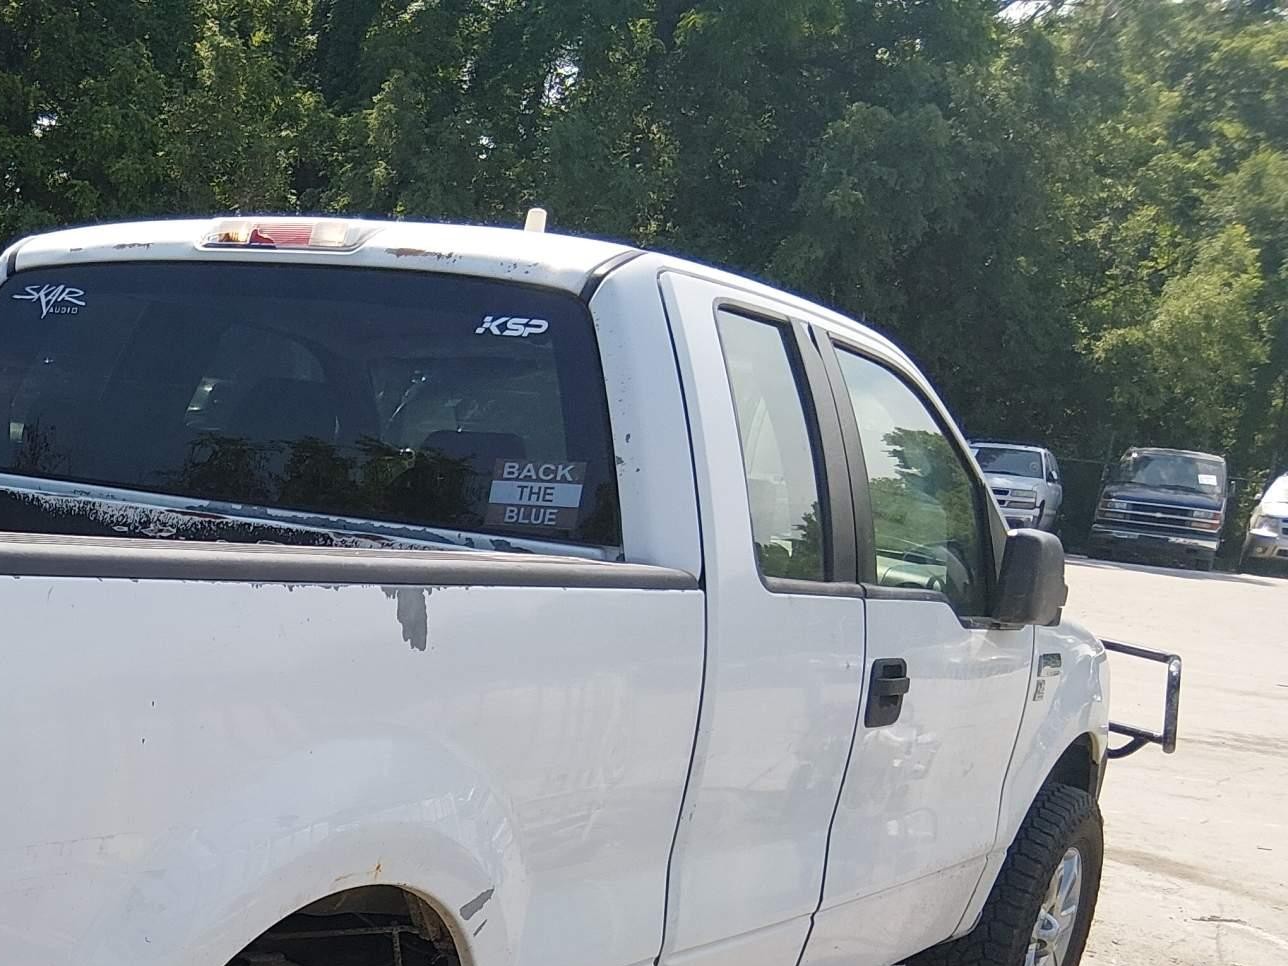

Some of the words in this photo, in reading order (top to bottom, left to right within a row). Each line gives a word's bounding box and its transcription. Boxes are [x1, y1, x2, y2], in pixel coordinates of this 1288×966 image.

[12, 284, 86, 319] SKAR
[49, 306, 79, 314] AUDIO
[475, 316, 549, 337] KSP
[503, 462, 575, 481] BACK
[517, 485, 555, 503] THE
[504, 506, 559, 525] BLUE
